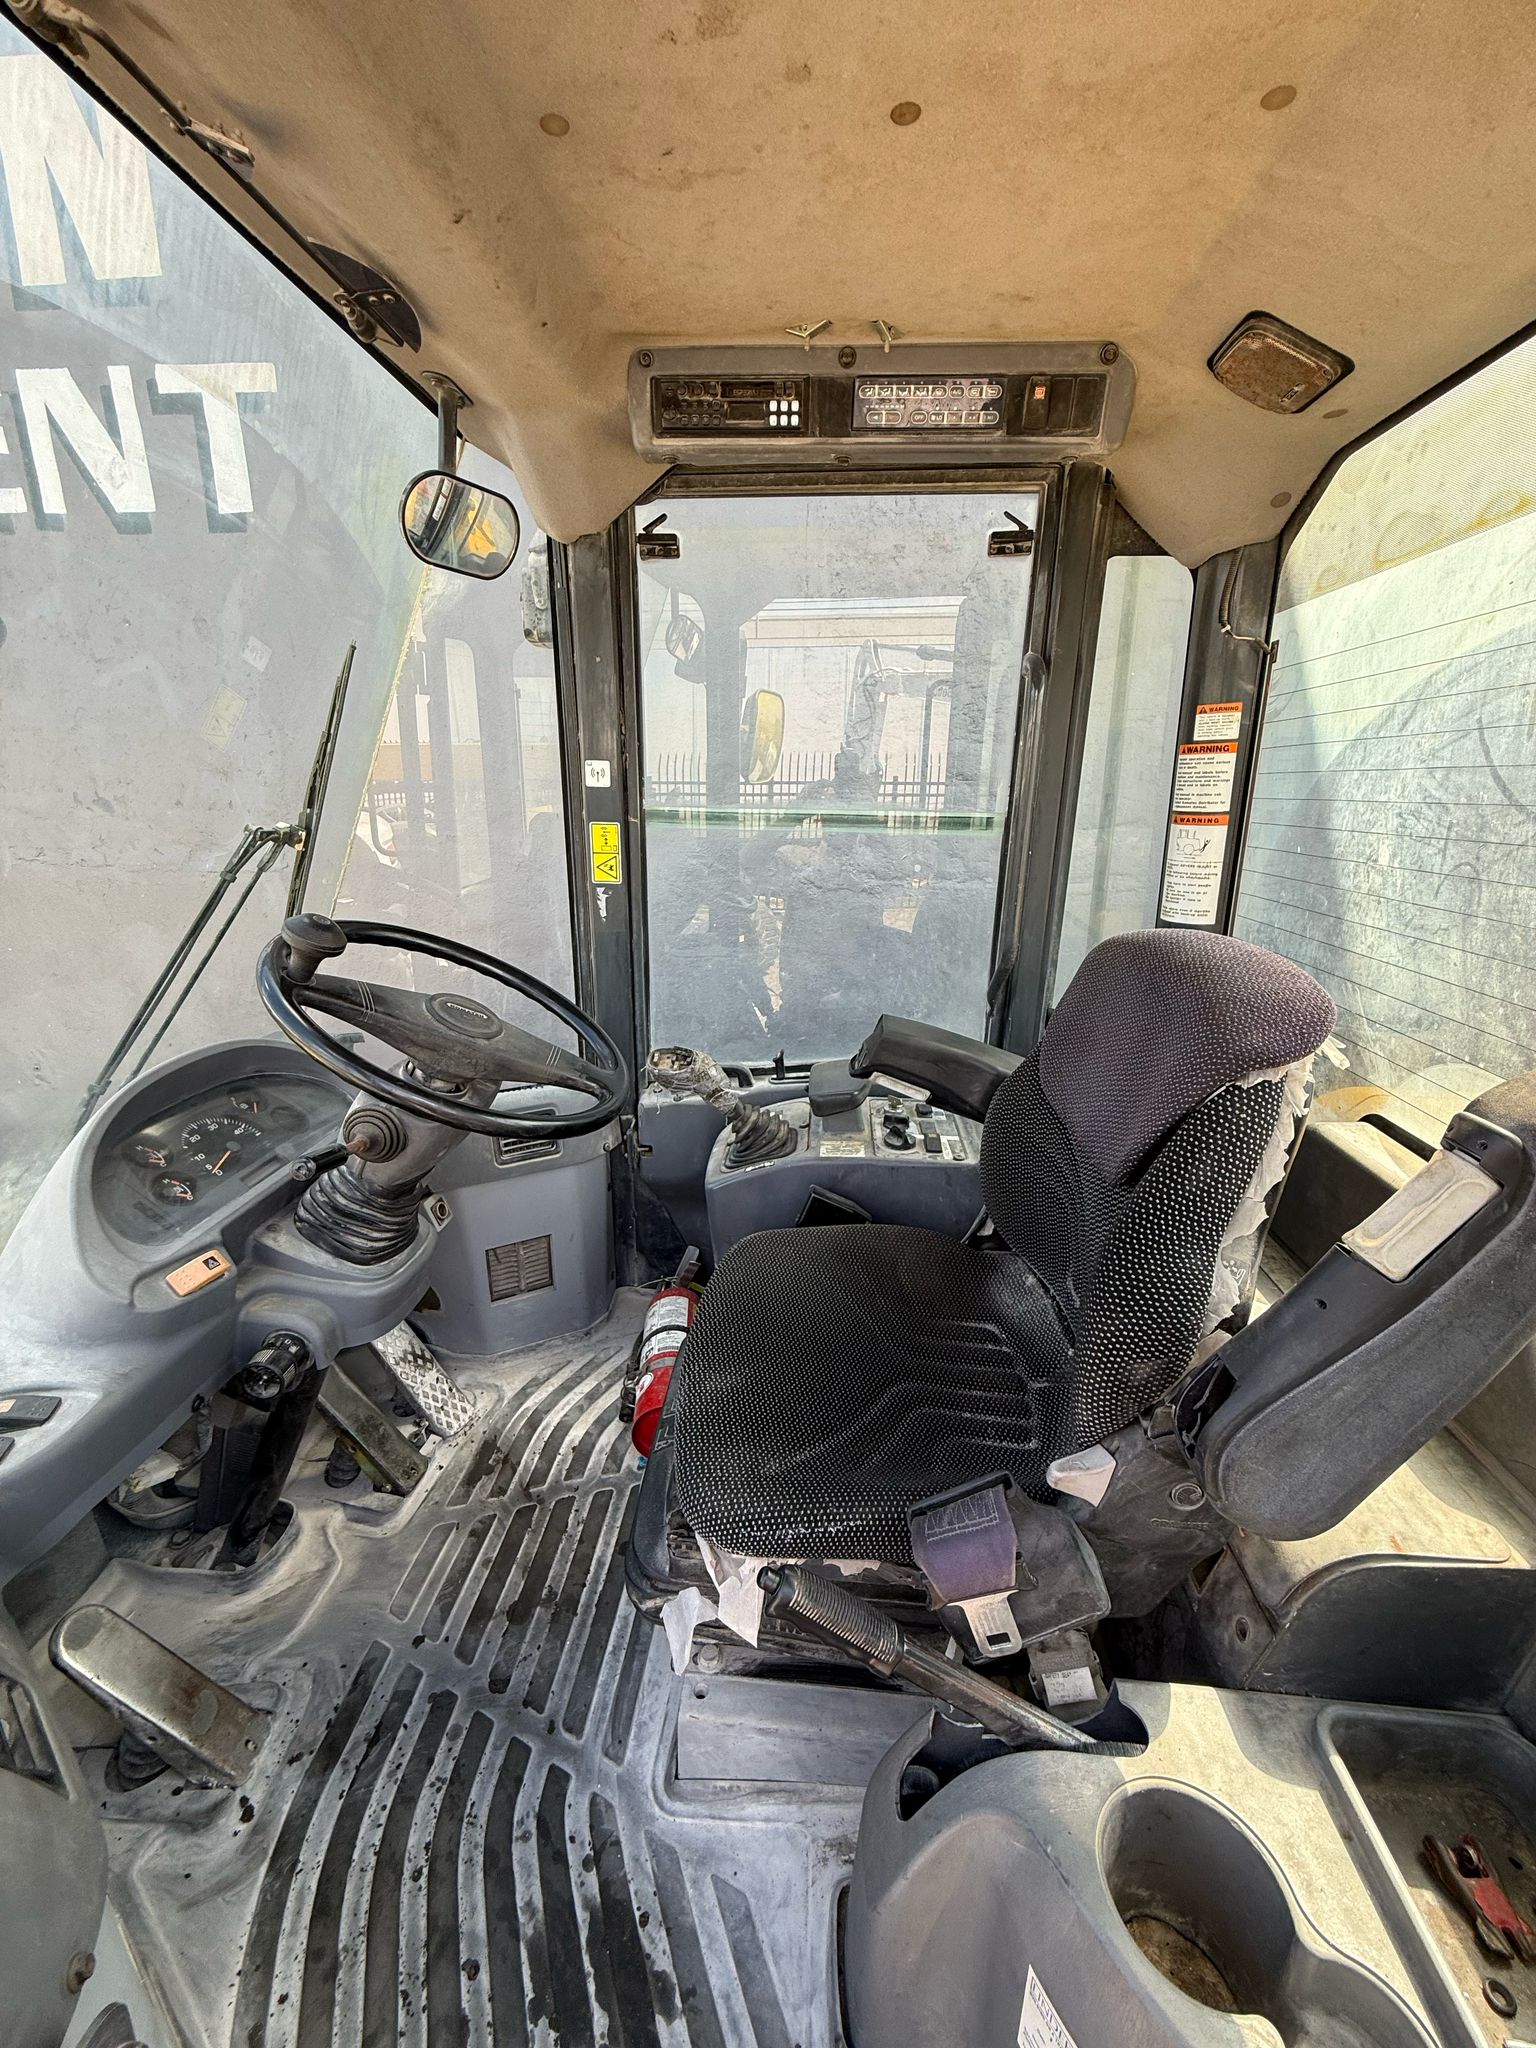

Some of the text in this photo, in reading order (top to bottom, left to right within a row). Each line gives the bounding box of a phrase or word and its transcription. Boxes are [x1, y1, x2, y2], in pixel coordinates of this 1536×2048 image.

[0, 363, 277, 514] NT
[1187, 745, 1230, 753] WARNING
[207, 1123, 219, 1131] 30
[234, 1127, 245, 1135] 40
[189, 1134, 201, 1143] 20
[195, 1153, 206, 1161] 10
